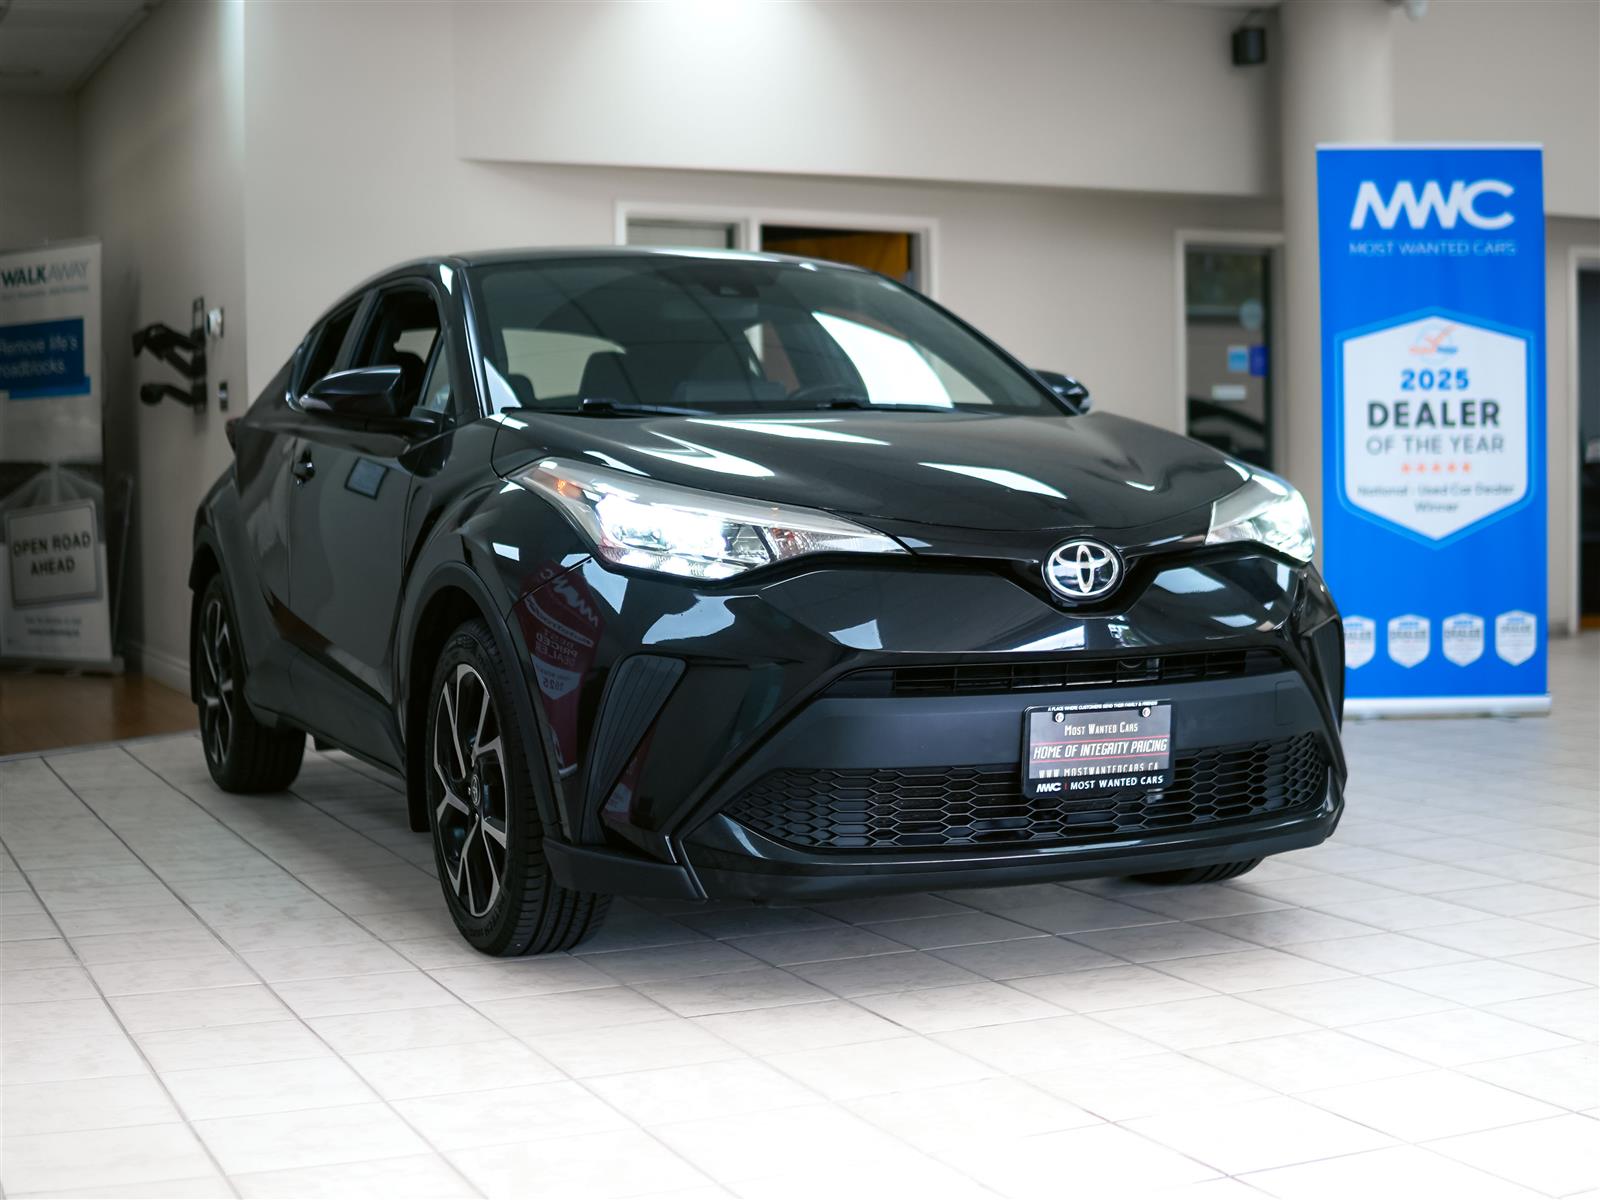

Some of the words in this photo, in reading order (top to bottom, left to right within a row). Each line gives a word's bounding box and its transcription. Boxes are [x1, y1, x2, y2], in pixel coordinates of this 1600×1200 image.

[1350, 180, 1515, 230] MWC
[1400, 369, 1470, 391] 2025
[1367, 400, 1500, 428] DEALER
[1366, 434, 1394, 455] OF
[1402, 435, 1442, 455] THE
[1449, 435, 1504, 454] YEAR
[14, 537, 49, 557] OPEN
[52, 531, 91, 550] ROAD
[30, 556, 76, 576] AHEAD
[1033, 745, 1061, 760] HOME
[1064, 744, 1079, 758] OF
[1080, 741, 1129, 757] INTEGRITY
[1131, 738, 1168, 754] PRICING
[1036, 782, 1062, 793] MWC
[1070, 780, 1096, 791] MOST
[1098, 777, 1138, 788] WANTED
[1140, 775, 1164, 785] CARS
